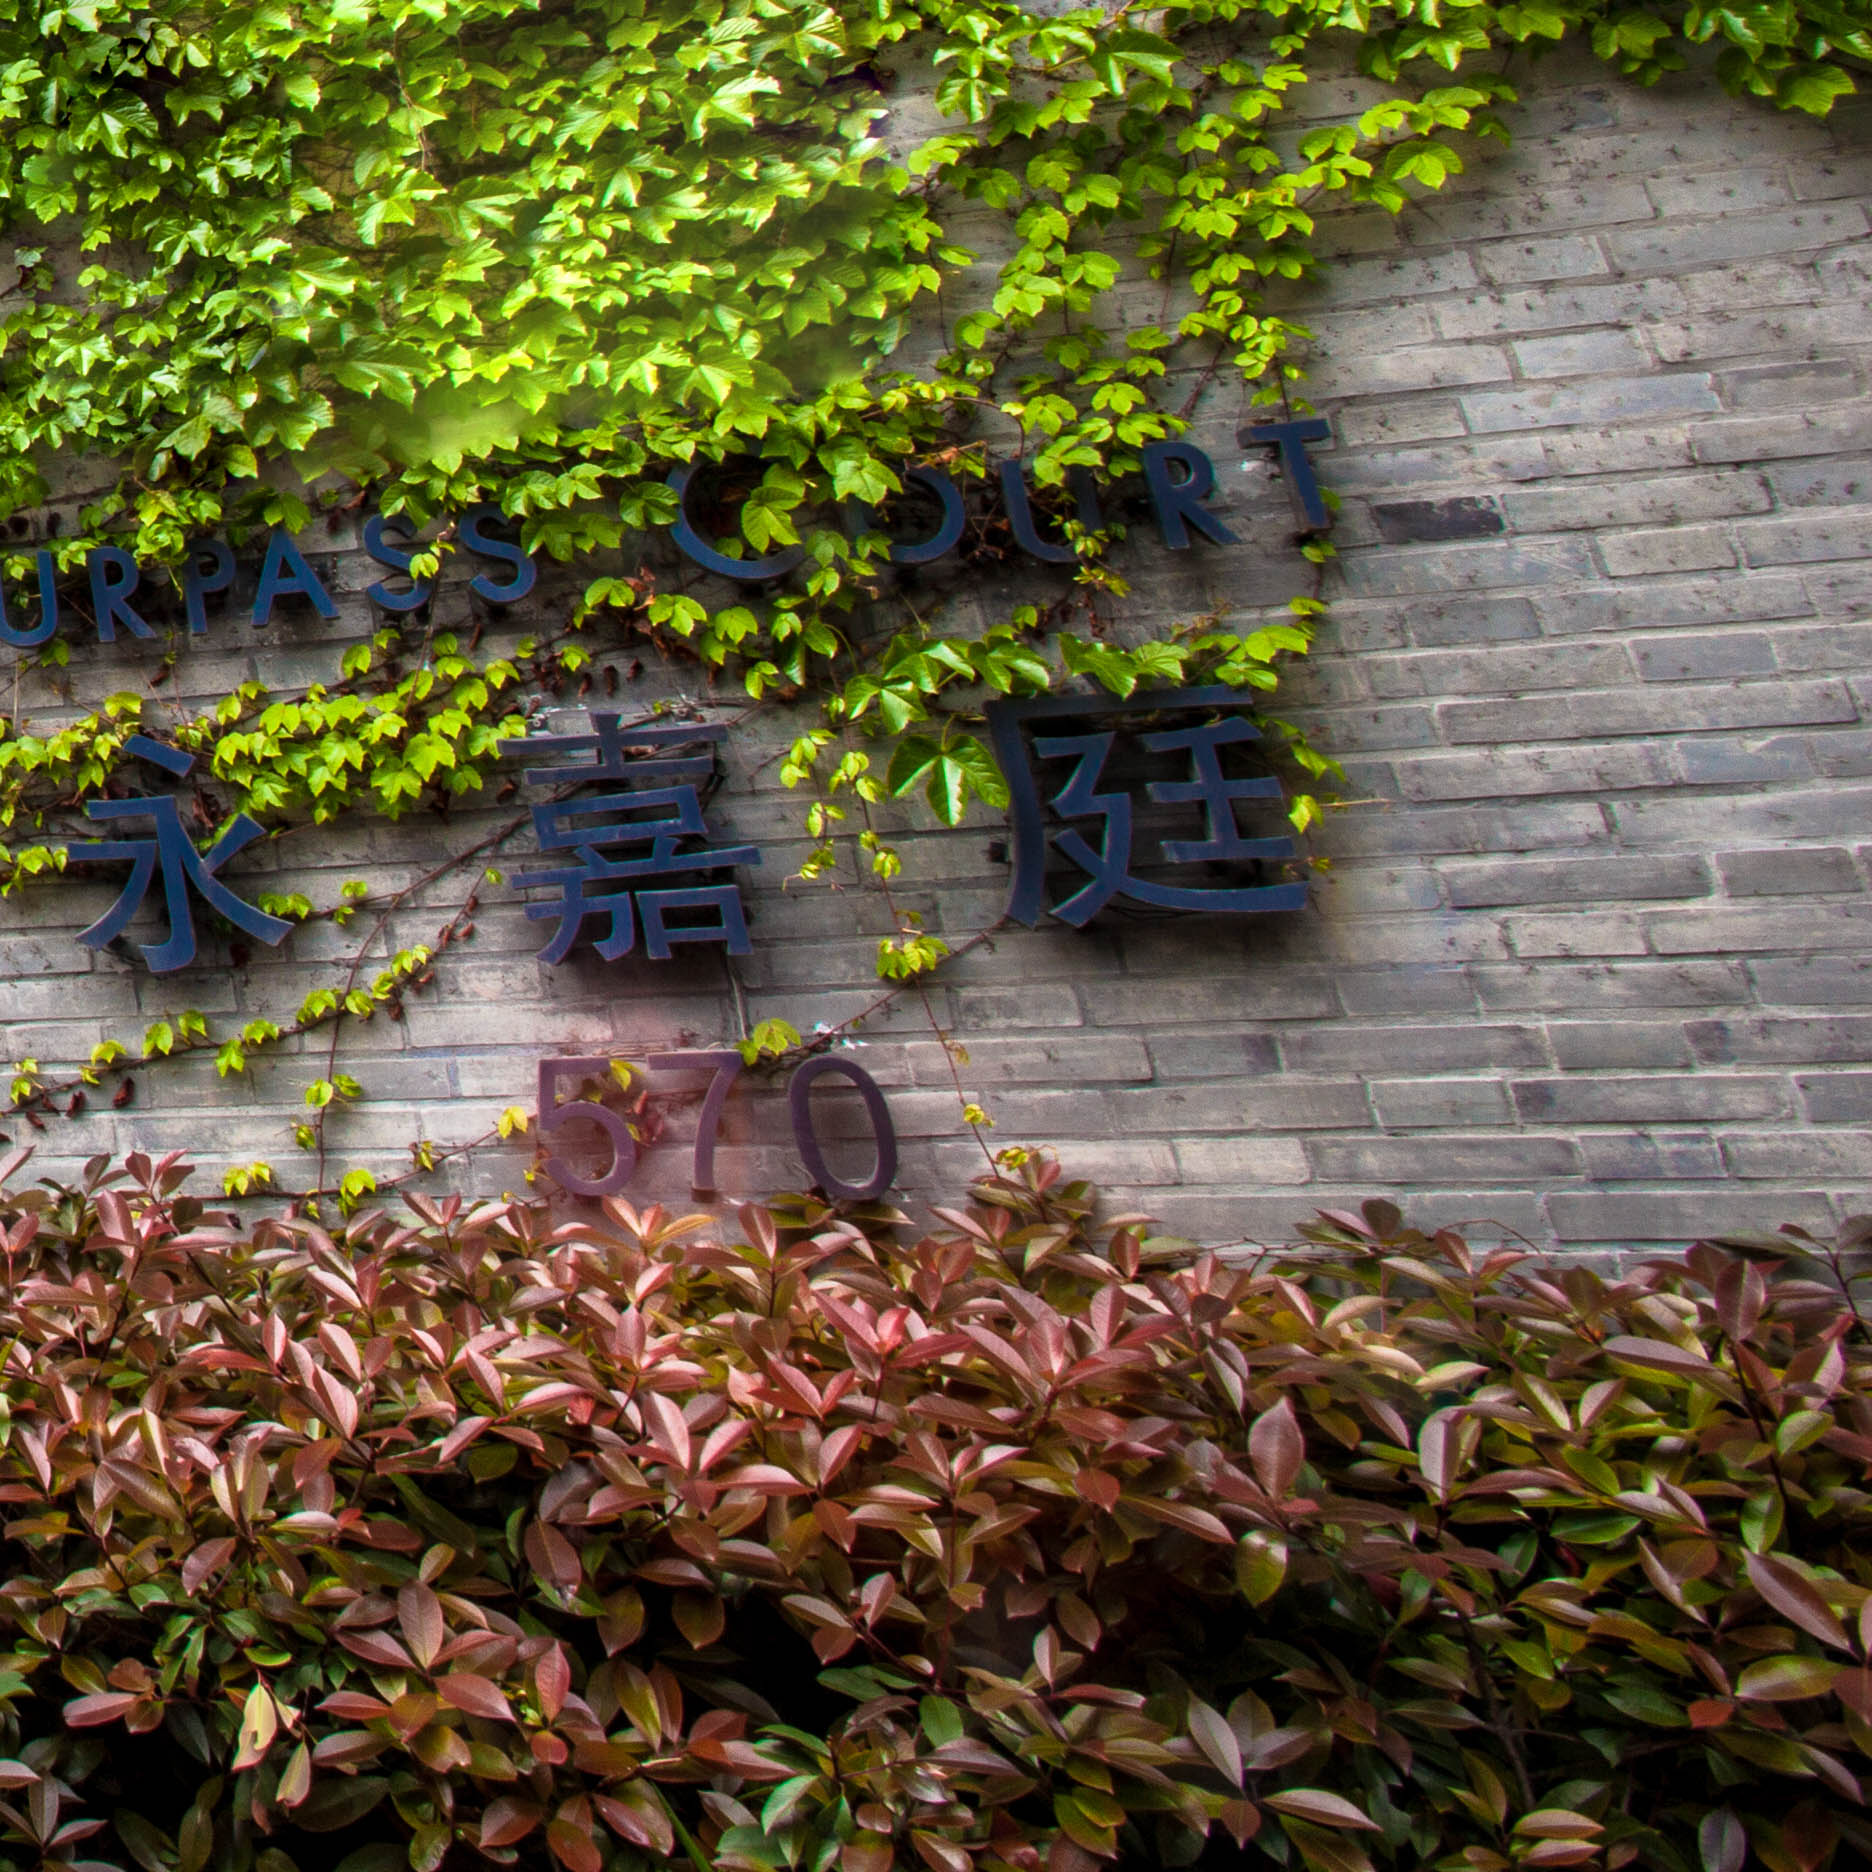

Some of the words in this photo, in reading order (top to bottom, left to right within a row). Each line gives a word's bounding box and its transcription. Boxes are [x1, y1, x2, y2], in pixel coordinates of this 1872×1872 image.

[66, 684, 1309, 974] 永嘉庭
[537, 1050, 898, 1204] 570
